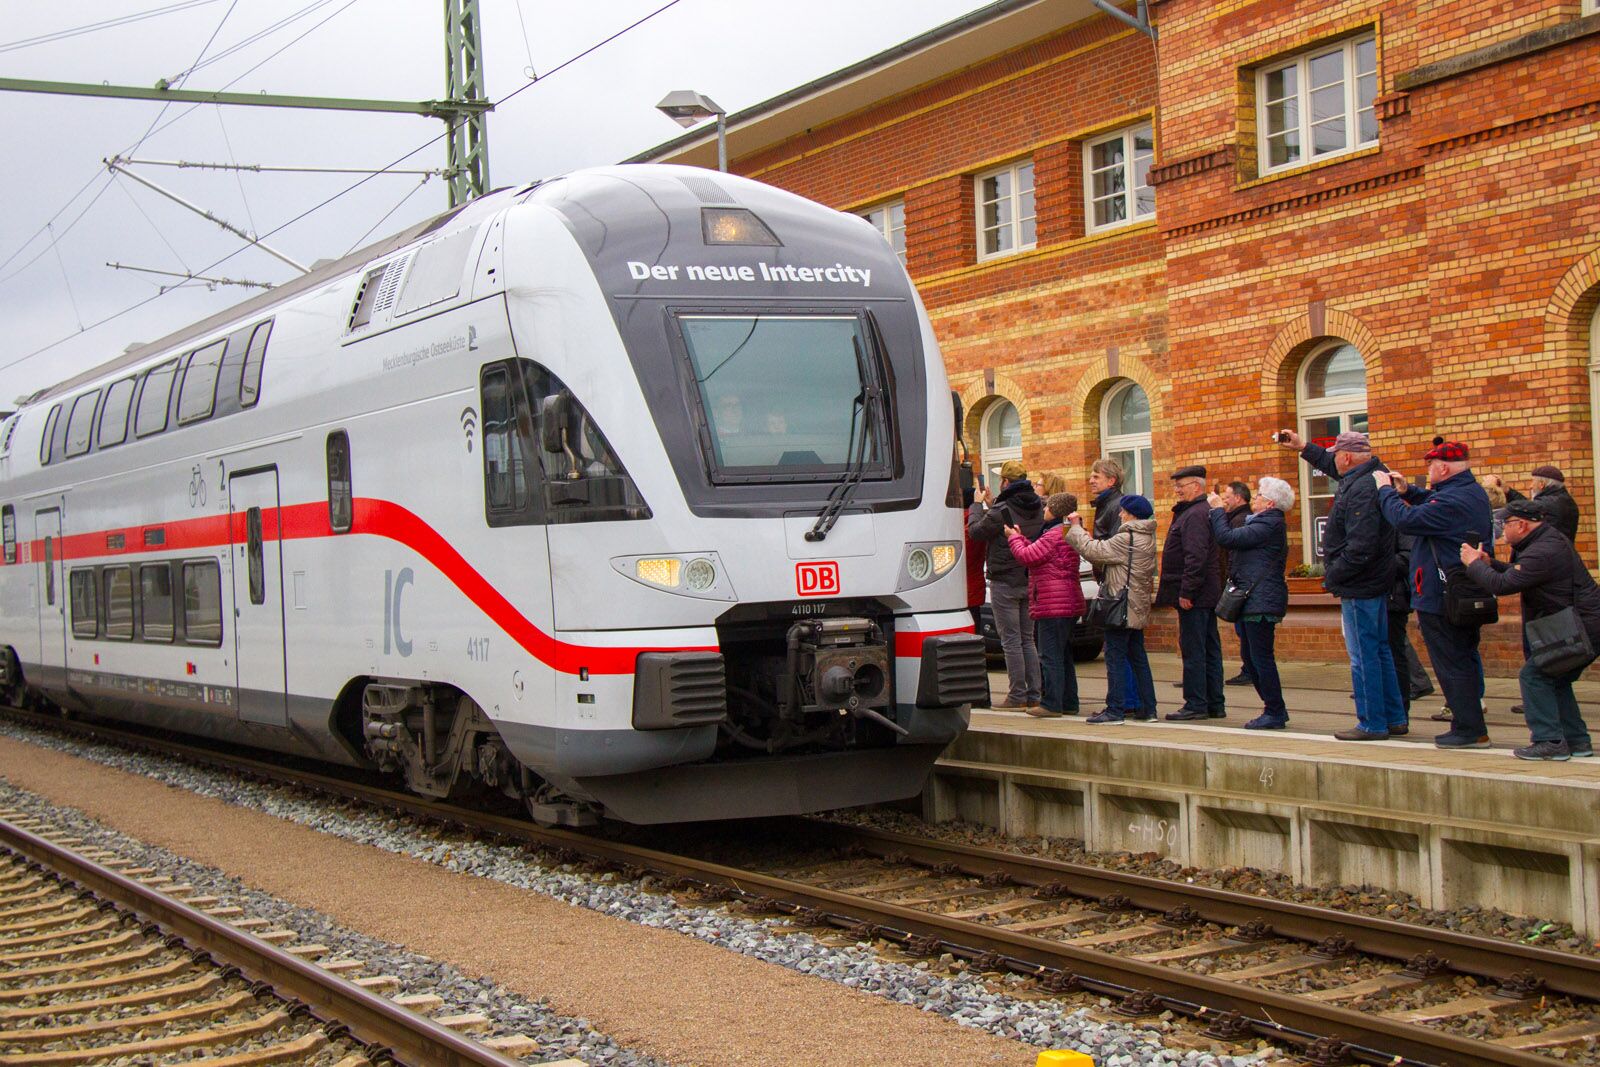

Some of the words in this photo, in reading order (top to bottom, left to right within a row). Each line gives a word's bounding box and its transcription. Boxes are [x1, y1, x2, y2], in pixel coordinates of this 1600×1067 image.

[627, 261, 679, 281] Der
[686, 263, 755, 282] neue
[758, 262, 871, 287] Intercity
[382, 347, 430, 371] Mecklenburgische
[430, 335, 466, 358] Ostseeküste
[219, 459, 225, 491] 2
[801, 567, 835, 590] DB
[383, 567, 414, 658] IC
[791, 604, 812, 615] 4110
[813, 603, 826, 614] 117
[467, 636, 490, 662] 4117
